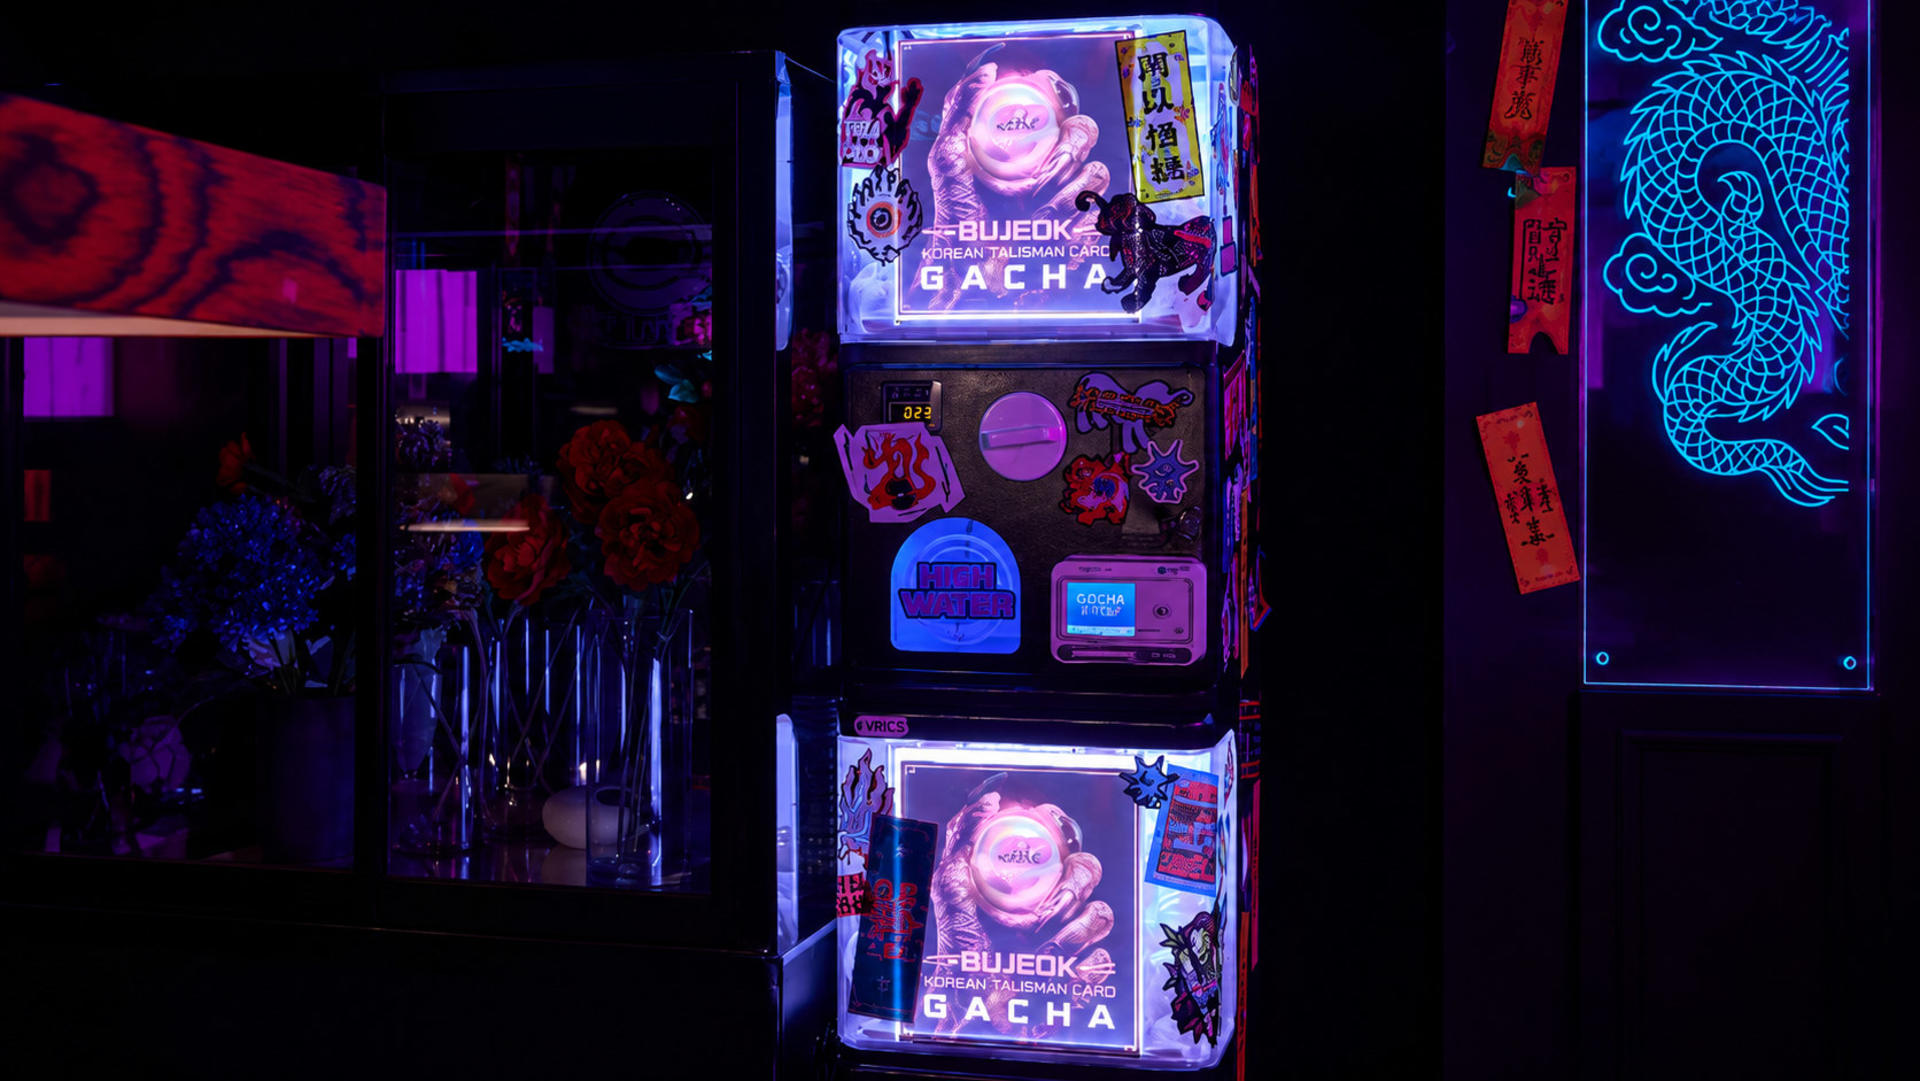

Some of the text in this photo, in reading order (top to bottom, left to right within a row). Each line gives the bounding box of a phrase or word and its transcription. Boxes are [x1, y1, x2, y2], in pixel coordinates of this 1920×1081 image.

[958, 219, 1073, 241] BUJEOK
[922, 247, 984, 260] KOREAN
[990, 246, 1065, 259] TALISMAN
[920, 264, 1108, 291] GACHA
[919, 563, 995, 589] HIGH
[900, 590, 1015, 617] WATER
[960, 950, 1078, 978] BUJEOK
[923, 975, 1116, 998] KOREAN TALISMAN CARD
[923, 993, 1116, 1030] GACHA
